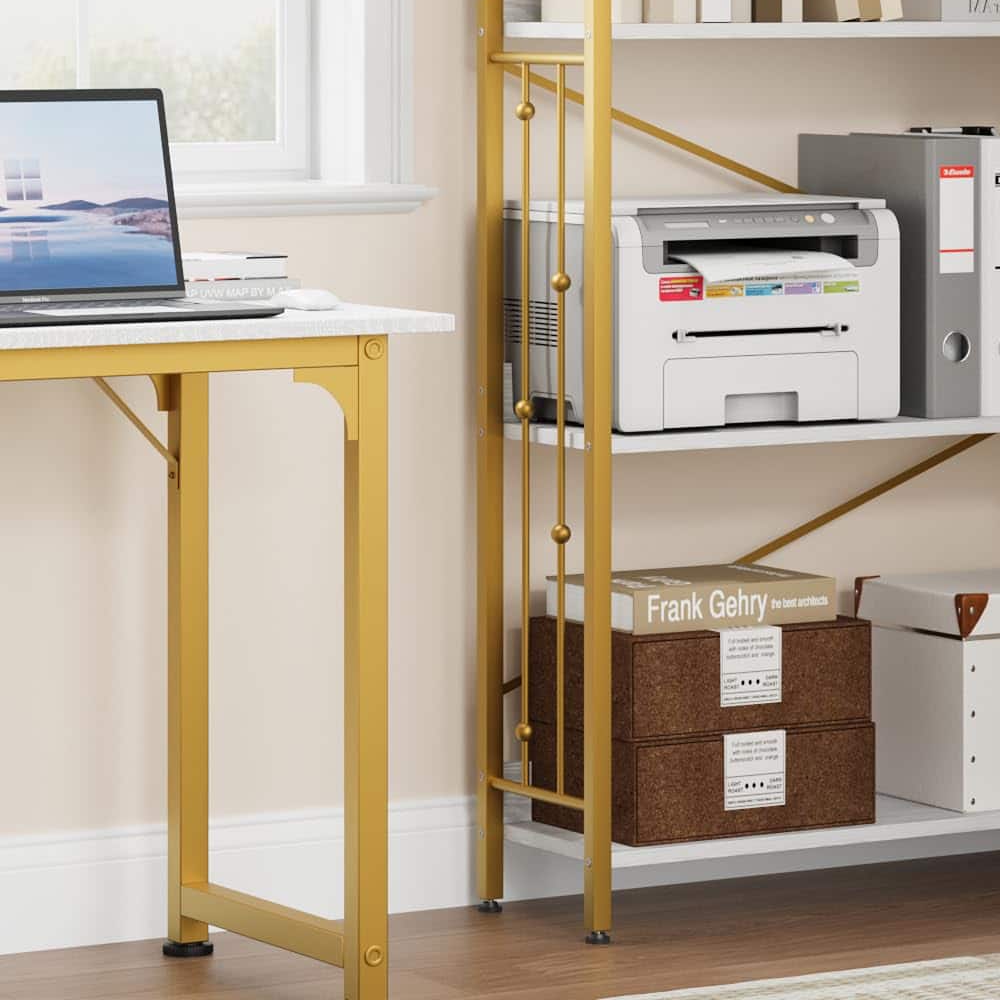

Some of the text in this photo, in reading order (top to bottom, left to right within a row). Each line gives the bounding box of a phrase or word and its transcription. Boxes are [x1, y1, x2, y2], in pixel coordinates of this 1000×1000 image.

[226, 288, 248, 297] MAP
[647, 592, 703, 623] Frank
[709, 587, 768, 622] Gehry
[771, 598, 781, 609] the
[798, 595, 828, 608] architects
